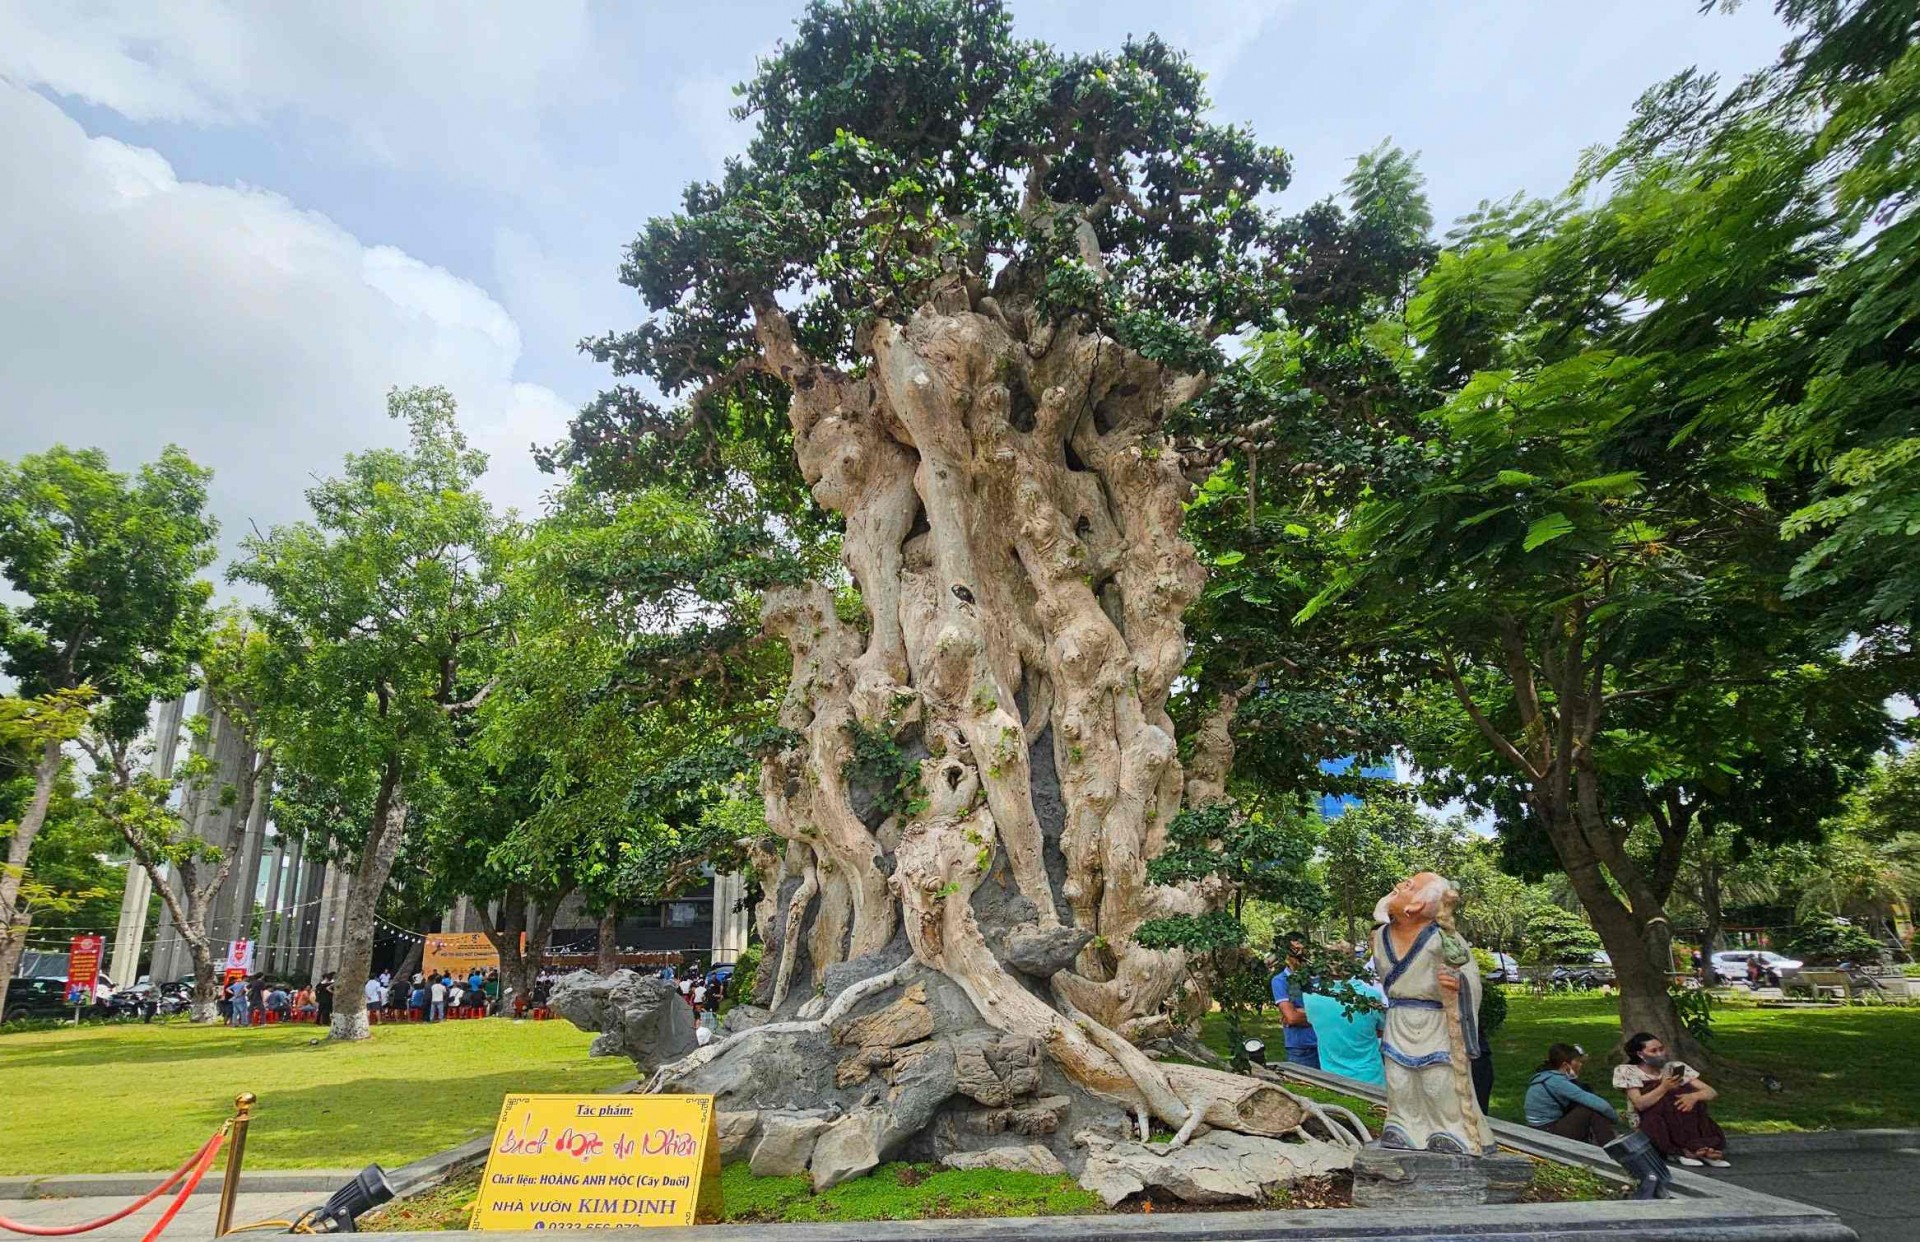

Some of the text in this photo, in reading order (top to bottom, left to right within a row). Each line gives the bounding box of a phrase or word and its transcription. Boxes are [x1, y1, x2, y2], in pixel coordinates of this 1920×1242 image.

[577, 1103, 597, 1115] Tác
[582, 1174, 607, 1186] ANH
[608, 1172, 635, 1188] MỘC
[492, 1198, 677, 1217] NHÀ VƯỜN KIM ĐỊNH
